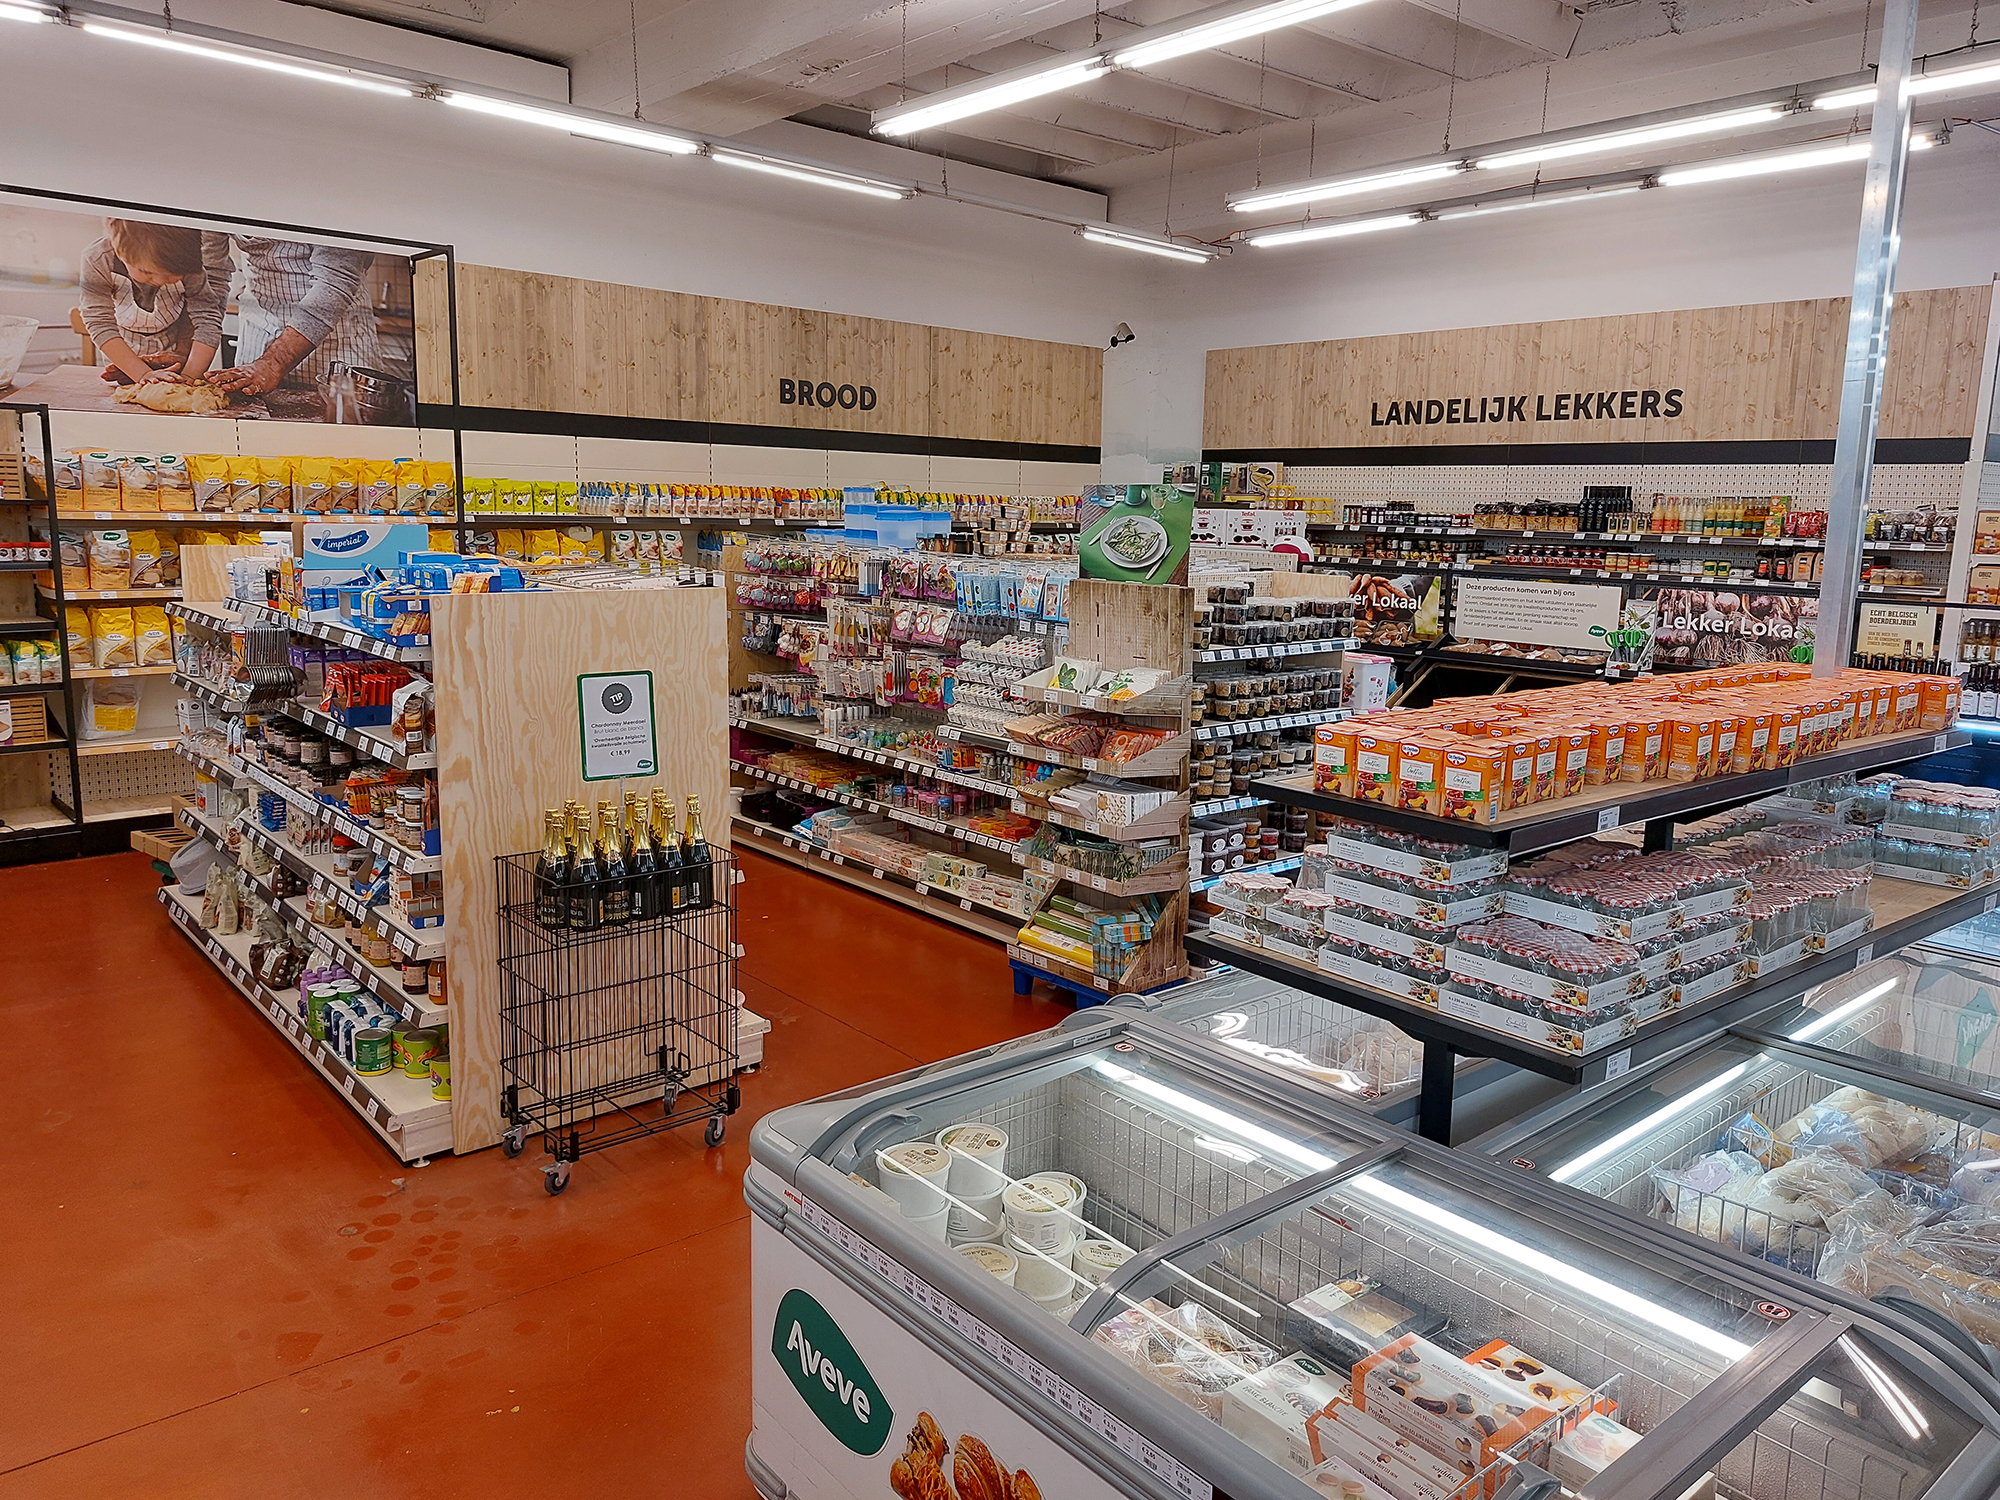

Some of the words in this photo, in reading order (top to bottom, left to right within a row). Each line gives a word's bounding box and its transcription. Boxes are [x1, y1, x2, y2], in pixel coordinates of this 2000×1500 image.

[780, 378, 877, 411] BROOD
[1371, 396, 1527, 426] LANDELIJK
[1536, 389, 1684, 421] LEKKERS
[327, 535, 362, 551] imperial
[1466, 583, 1482, 591] Deze
[1482, 585, 1516, 593] producten
[1516, 586, 1539, 594] komen
[1553, 588, 1563, 597] bij
[1372, 592, 1422, 610] Lokaal
[1663, 612, 1733, 633] Lekker
[1869, 617, 1917, 626] BOERDERIJBIER
[1888, 610, 1919, 619] BELGISCH
[609, 692, 623, 702] TIP
[786, 1319, 870, 1424] Aveve
[1299, 1360, 1321, 1375] Aveve
[1366, 1382, 1390, 1402] Poppies
[1367, 1405, 1391, 1424] Poppies
[1431, 1464, 1459, 1484] Poppies
